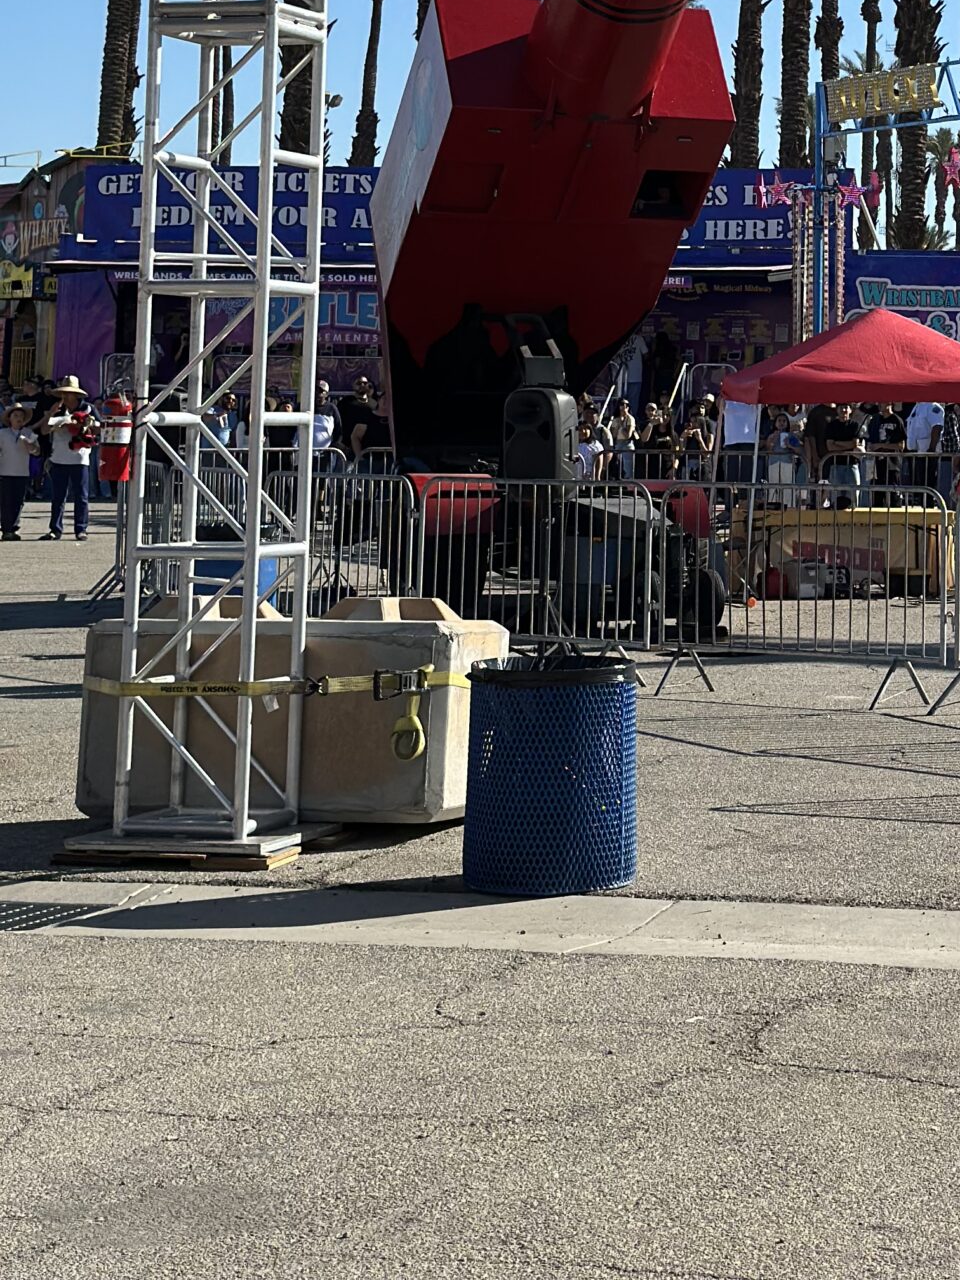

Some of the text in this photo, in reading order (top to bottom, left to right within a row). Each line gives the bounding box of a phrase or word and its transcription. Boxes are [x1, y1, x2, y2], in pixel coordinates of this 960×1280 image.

[258, 171, 373, 195] ICETS
[131, 205, 245, 227] EDEM
[328, 274, 356, 282] SOLD
[284, 331, 379, 342] AMEMENTS
